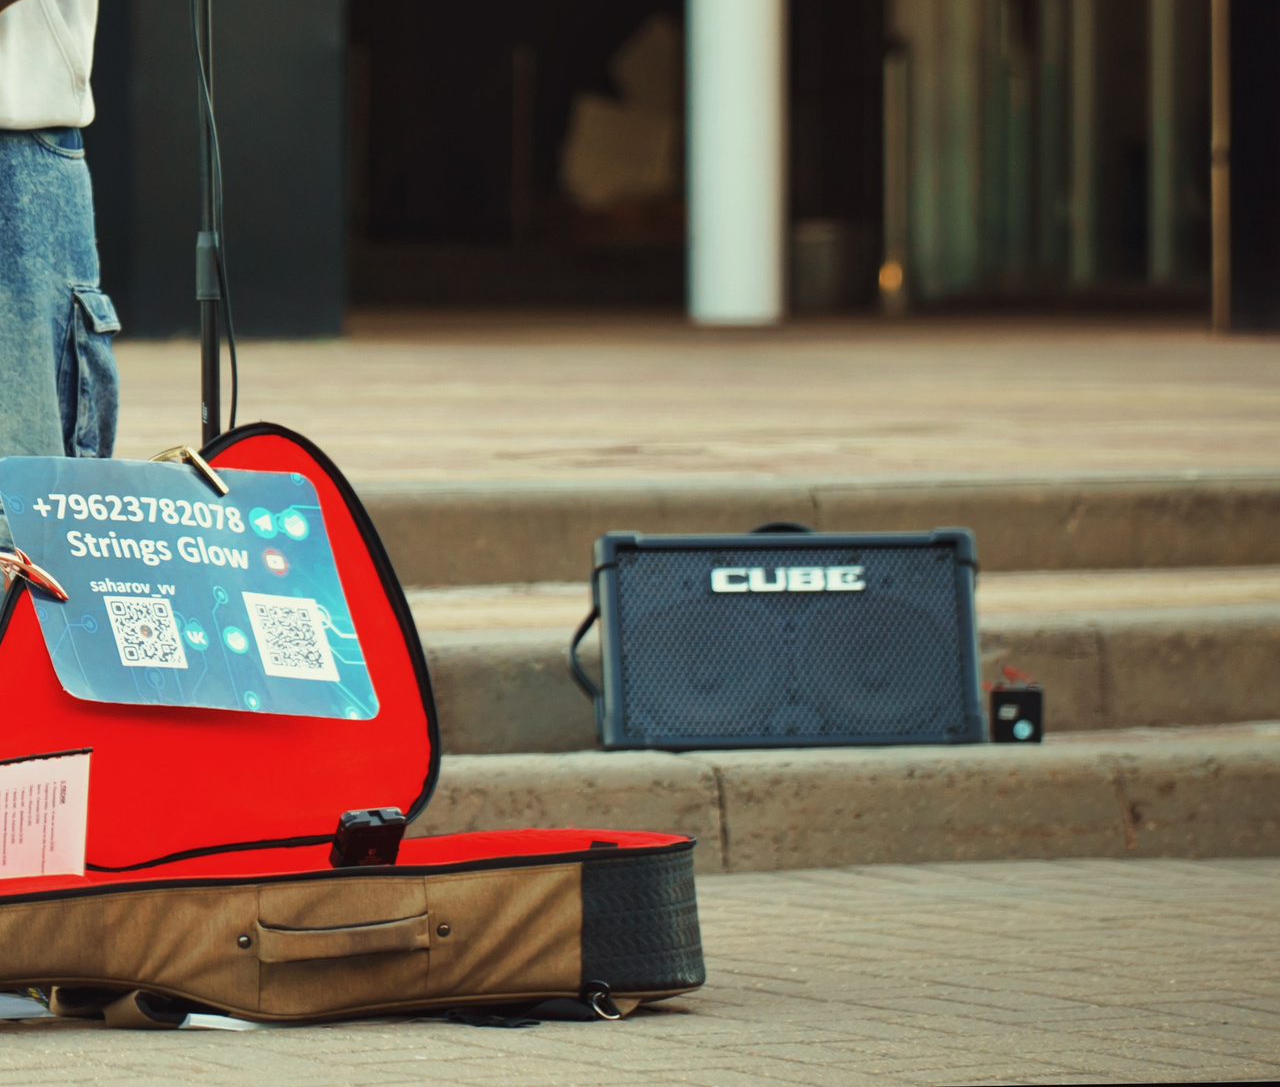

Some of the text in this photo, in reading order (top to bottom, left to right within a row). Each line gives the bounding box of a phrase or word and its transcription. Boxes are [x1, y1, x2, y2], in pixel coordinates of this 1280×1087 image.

[33, 493, 247, 534] +79623782078
[66, 530, 250, 570] Strings Glow
[89, 577, 176, 599] saharov_vv
[710, 566, 866, 593] CUBE
